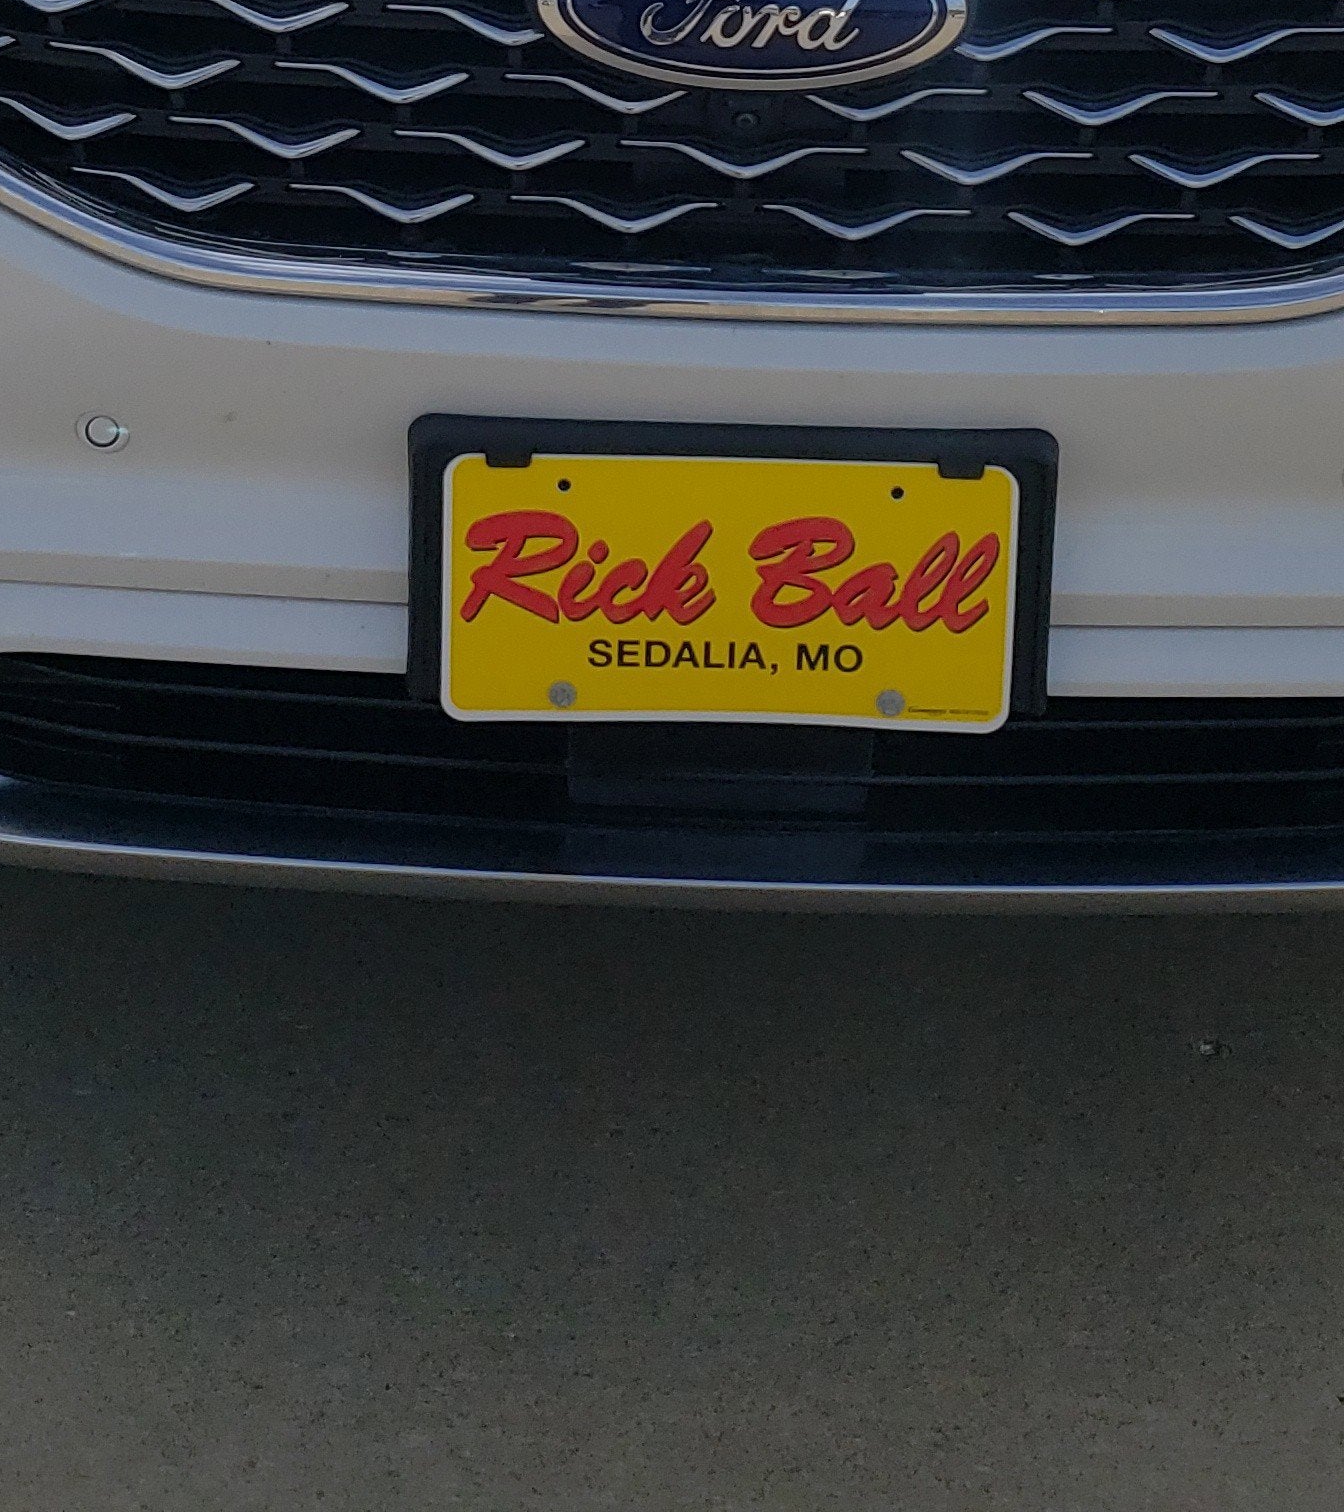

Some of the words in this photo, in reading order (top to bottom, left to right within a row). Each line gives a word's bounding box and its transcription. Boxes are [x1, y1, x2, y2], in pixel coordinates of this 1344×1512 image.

[460, 509, 715, 624] Rick
[748, 515, 1001, 633] Ball
[587, 639, 779, 675] SEDALIA,
[795, 642, 865, 673] MO
